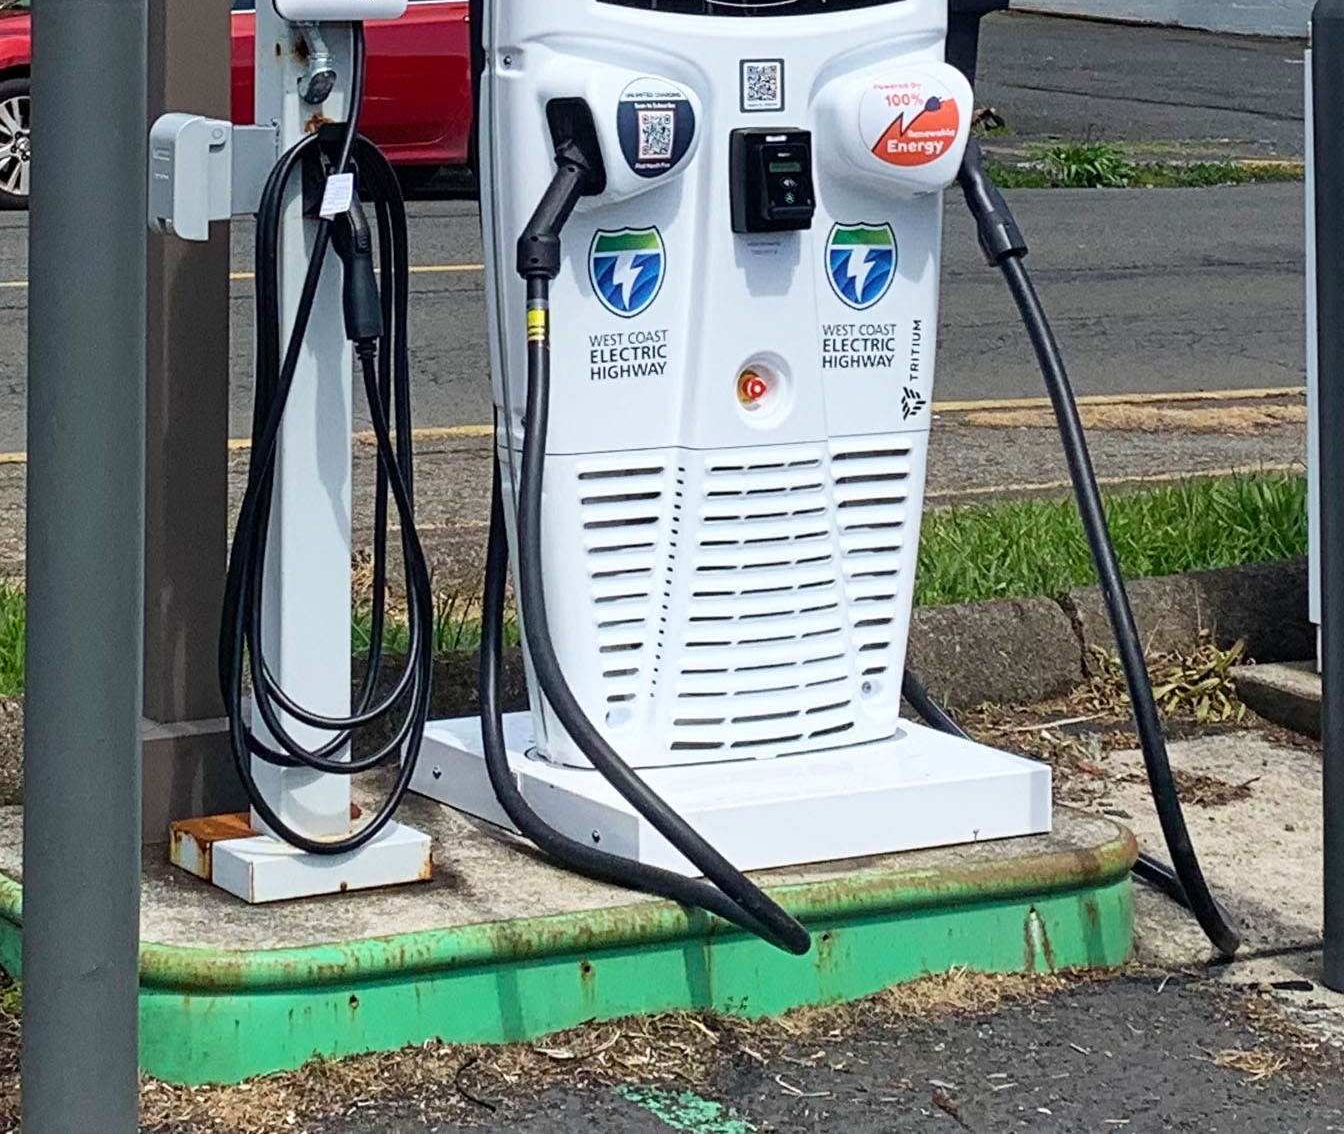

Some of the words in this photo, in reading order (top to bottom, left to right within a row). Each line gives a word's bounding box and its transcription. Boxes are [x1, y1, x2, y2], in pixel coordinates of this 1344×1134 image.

[885, 93, 924, 107] 100%
[887, 139, 944, 155] Energy
[822, 324, 856, 336] WEST
[858, 323, 896, 336] COAST
[589, 332, 624, 347] WEST
[628, 329, 668, 345] COAST
[823, 338, 895, 352] ELECTRIC
[590, 344, 667, 364] ELECTRIC
[909, 319, 922, 382] TRITIUM
[822, 354, 895, 368] HIGHWAY
[590, 361, 667, 381] HIGHWAY
